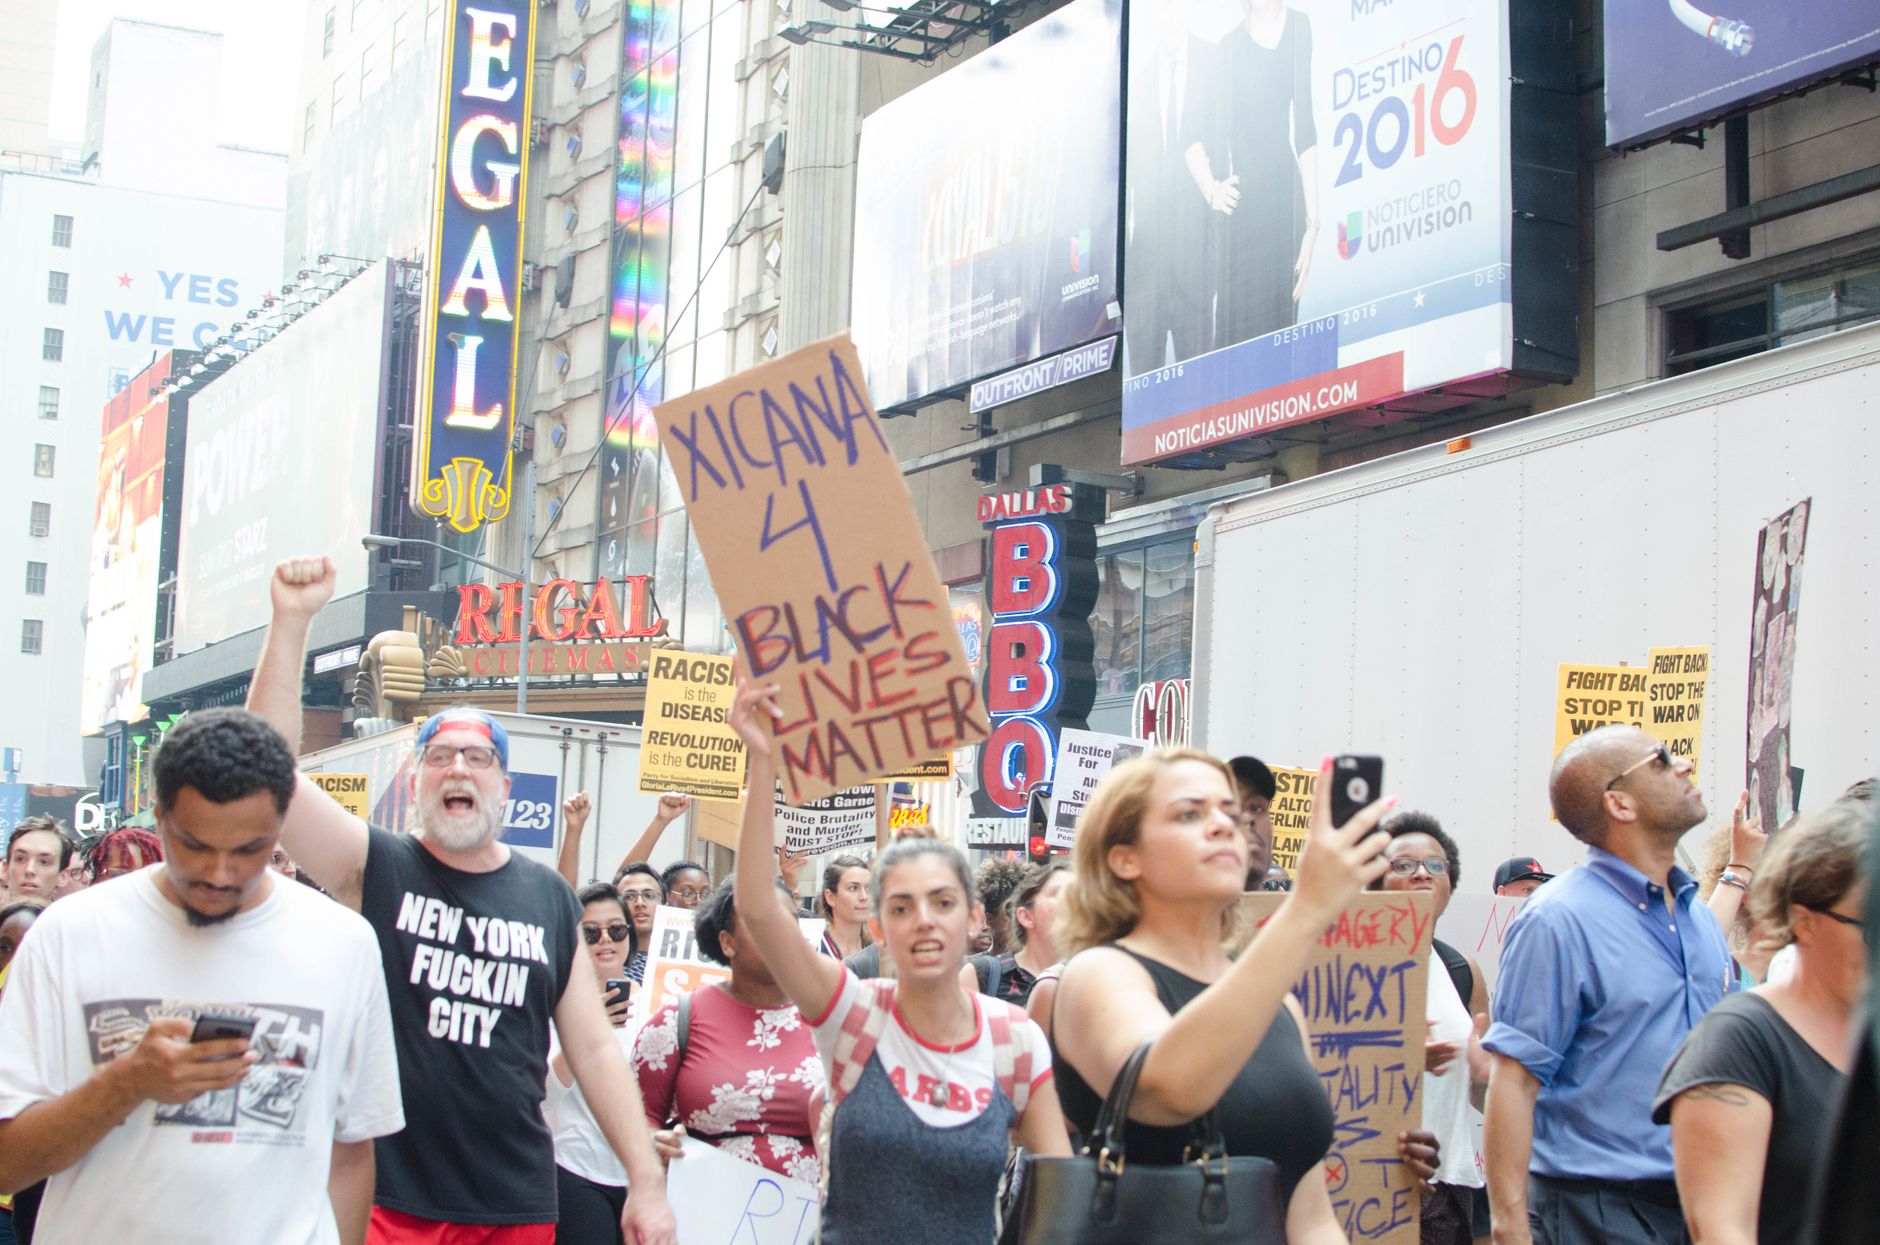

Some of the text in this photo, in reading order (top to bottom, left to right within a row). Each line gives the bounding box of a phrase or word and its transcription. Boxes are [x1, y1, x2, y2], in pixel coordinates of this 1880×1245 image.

[1333, 42, 1443, 112] DESTINO
[1333, 34, 1477, 188] 2016
[440, 7, 520, 430] EGAL
[1367, 178, 1461, 229] NOTICIERO
[157, 270, 239, 308] YES
[104, 310, 176, 346] WE
[1274, 304, 1377, 346] DESTINO 2016
[974, 344, 1109, 407] OUTFRONT PRIME
[1155, 366, 1184, 384] 2016
[670, 347, 889, 501] XICANA
[1155, 379, 1358, 454] NOTICIASUNIVISION.COM
[976, 485, 1070, 522] DALLAS
[759, 478, 838, 593] 4
[454, 575, 667, 644] REGAL
[735, 560, 936, 677] BLACK
[474, 645, 639, 674] CINEMAS
[983, 521, 1060, 814] BBQ
[1652, 653, 1708, 674] FIGHT BACK!
[684, 687, 717, 703] is the
[771, 630, 951, 737] LIVES
[1566, 671, 1617, 691] FIGHT
[1650, 681, 1704, 701] STOP THE
[1564, 698, 1622, 716] STOP
[1653, 703, 1700, 723] WAR ON
[647, 730, 744, 753] REVOLUTION
[779, 675, 990, 801] MATTER
[1067, 742, 1112, 758] Justice
[649, 751, 737, 772] is the CURE!
[1078, 757, 1098, 770] For
[310, 778, 366, 792] ACISM
[775, 808, 875, 824] Police Brutality
[787, 823, 861, 835] and Murder
[786, 829, 863, 847] MUST STOP!
[396, 891, 548, 965] NEW YORK
[409, 943, 529, 1007] FUCKIN
[427, 996, 501, 1048] CITY
